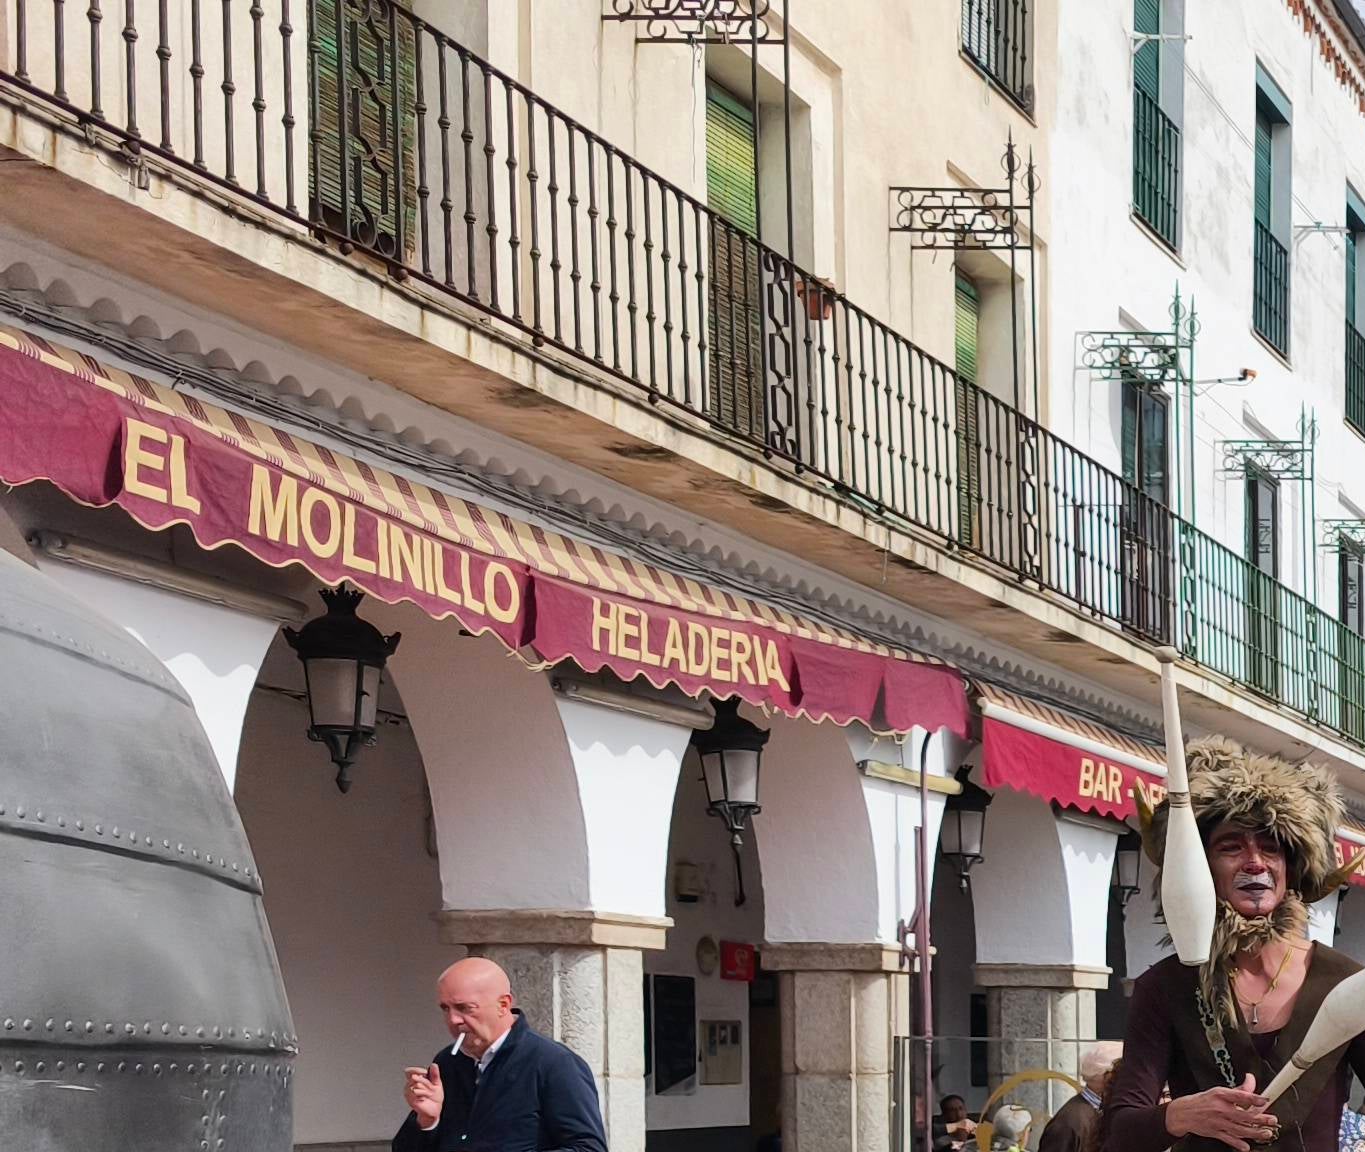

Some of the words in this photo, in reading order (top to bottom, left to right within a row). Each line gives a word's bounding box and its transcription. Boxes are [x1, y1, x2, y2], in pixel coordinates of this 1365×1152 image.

[122, 416, 202, 515] EL
[247, 463, 521, 625] MOLINILLO
[590, 596, 791, 692] HELADERIA
[1078, 757, 1123, 805] BAR
